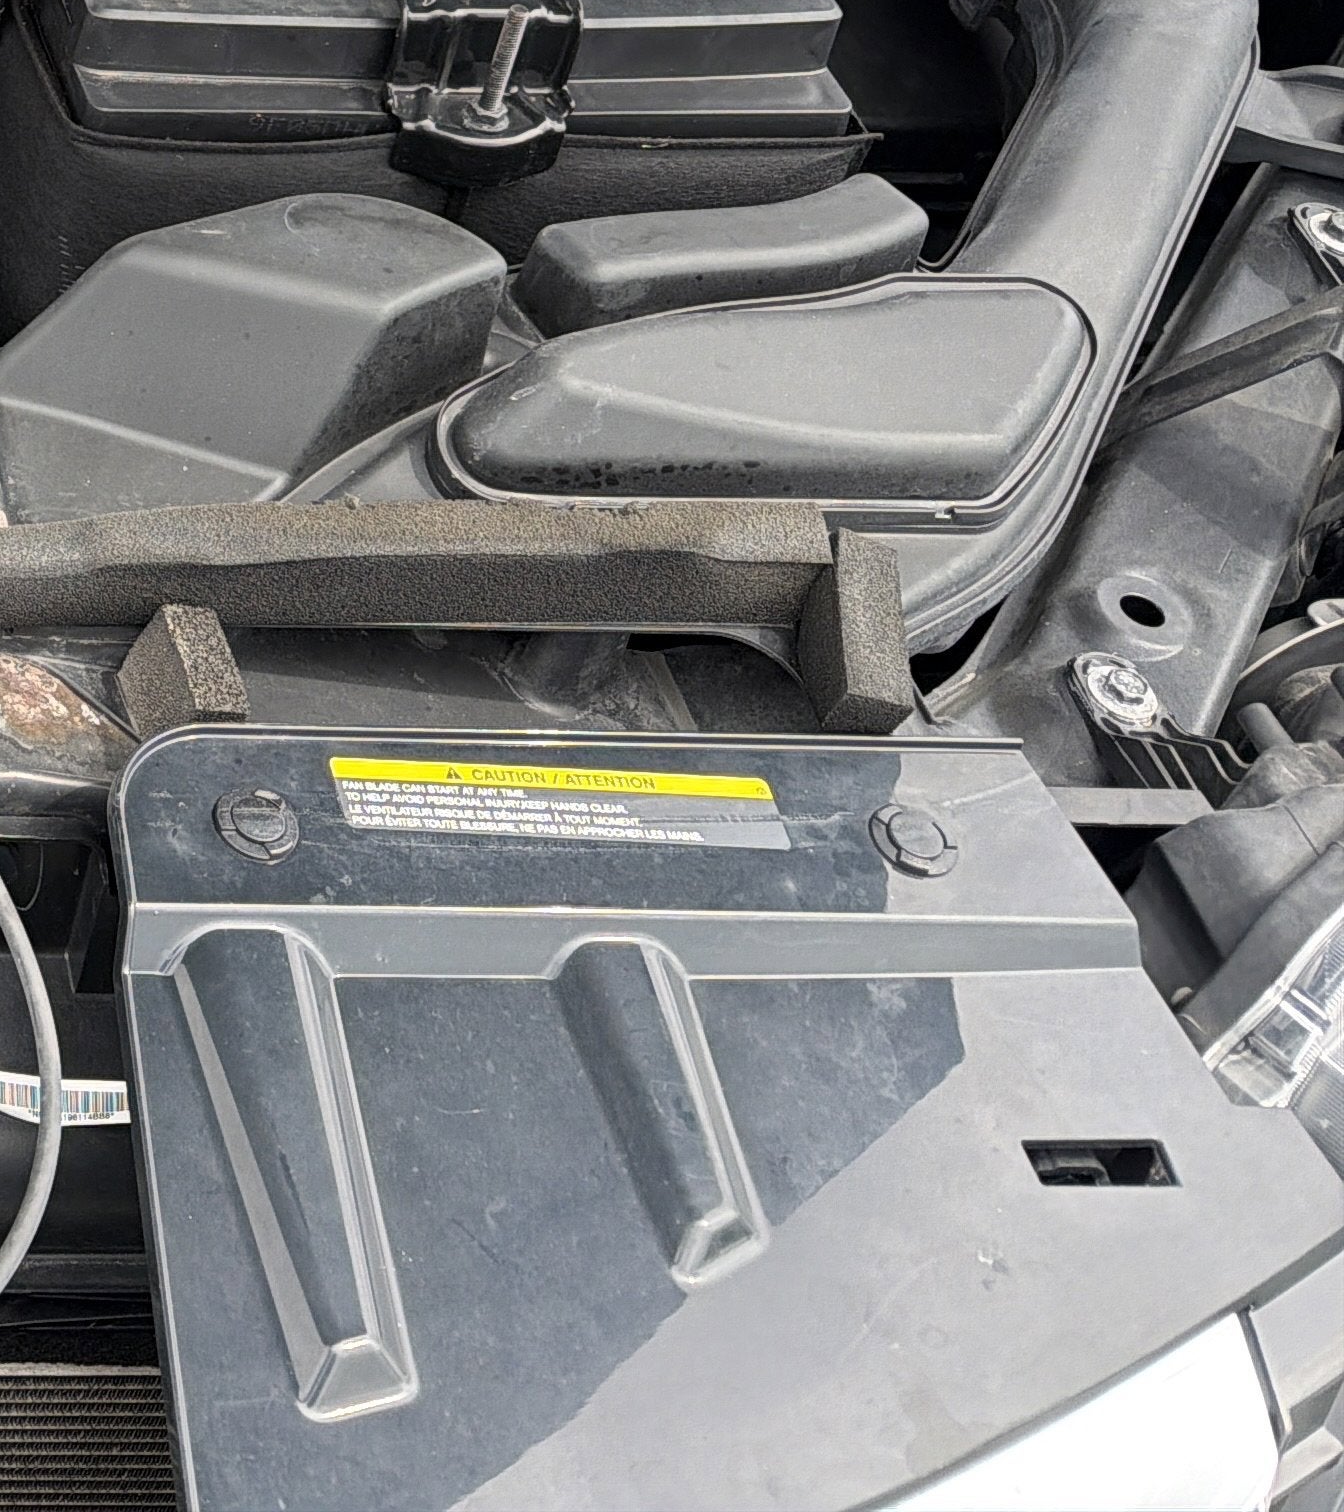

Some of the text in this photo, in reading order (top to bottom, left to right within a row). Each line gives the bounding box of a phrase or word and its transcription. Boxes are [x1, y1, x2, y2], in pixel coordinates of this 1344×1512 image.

[342, 780, 363, 790] FAN
[365, 782, 400, 792] BLADE
[402, 783, 425, 794] CAN
[427, 784, 460, 795] START
[462, 786, 474, 796] AT
[476, 787, 498, 797] ANY
[472, 768, 546, 784] CAUTION
[565, 773, 656, 790] ATTENTION
[345, 791, 360, 801] TO
[362, 792, 390, 803] HELP
[392, 794, 424, 805] AVOID
[426, 795, 484, 808] PERSONAL
[550, 801, 588, 813] HANDS
[348, 804, 362, 814] LE
[364, 805, 433, 818] VENTILATEUR
[435, 807, 476, 820] RISQUE
[477, 809, 492, 820] DE
[494, 809, 552, 823] DÉMARRER
[564, 814, 591, 825] TOUT
[352, 815, 384, 826] POUR
[385, 814, 422, 828] ÉVITER
[423, 818, 459, 830] TOUTE
[520, 823, 536, 834] NE
[537, 824, 559, 835] PAS
[562, 825, 576, 836] EN
[577, 826, 644, 839] APPROCHER
[645, 829, 666, 840] LES
